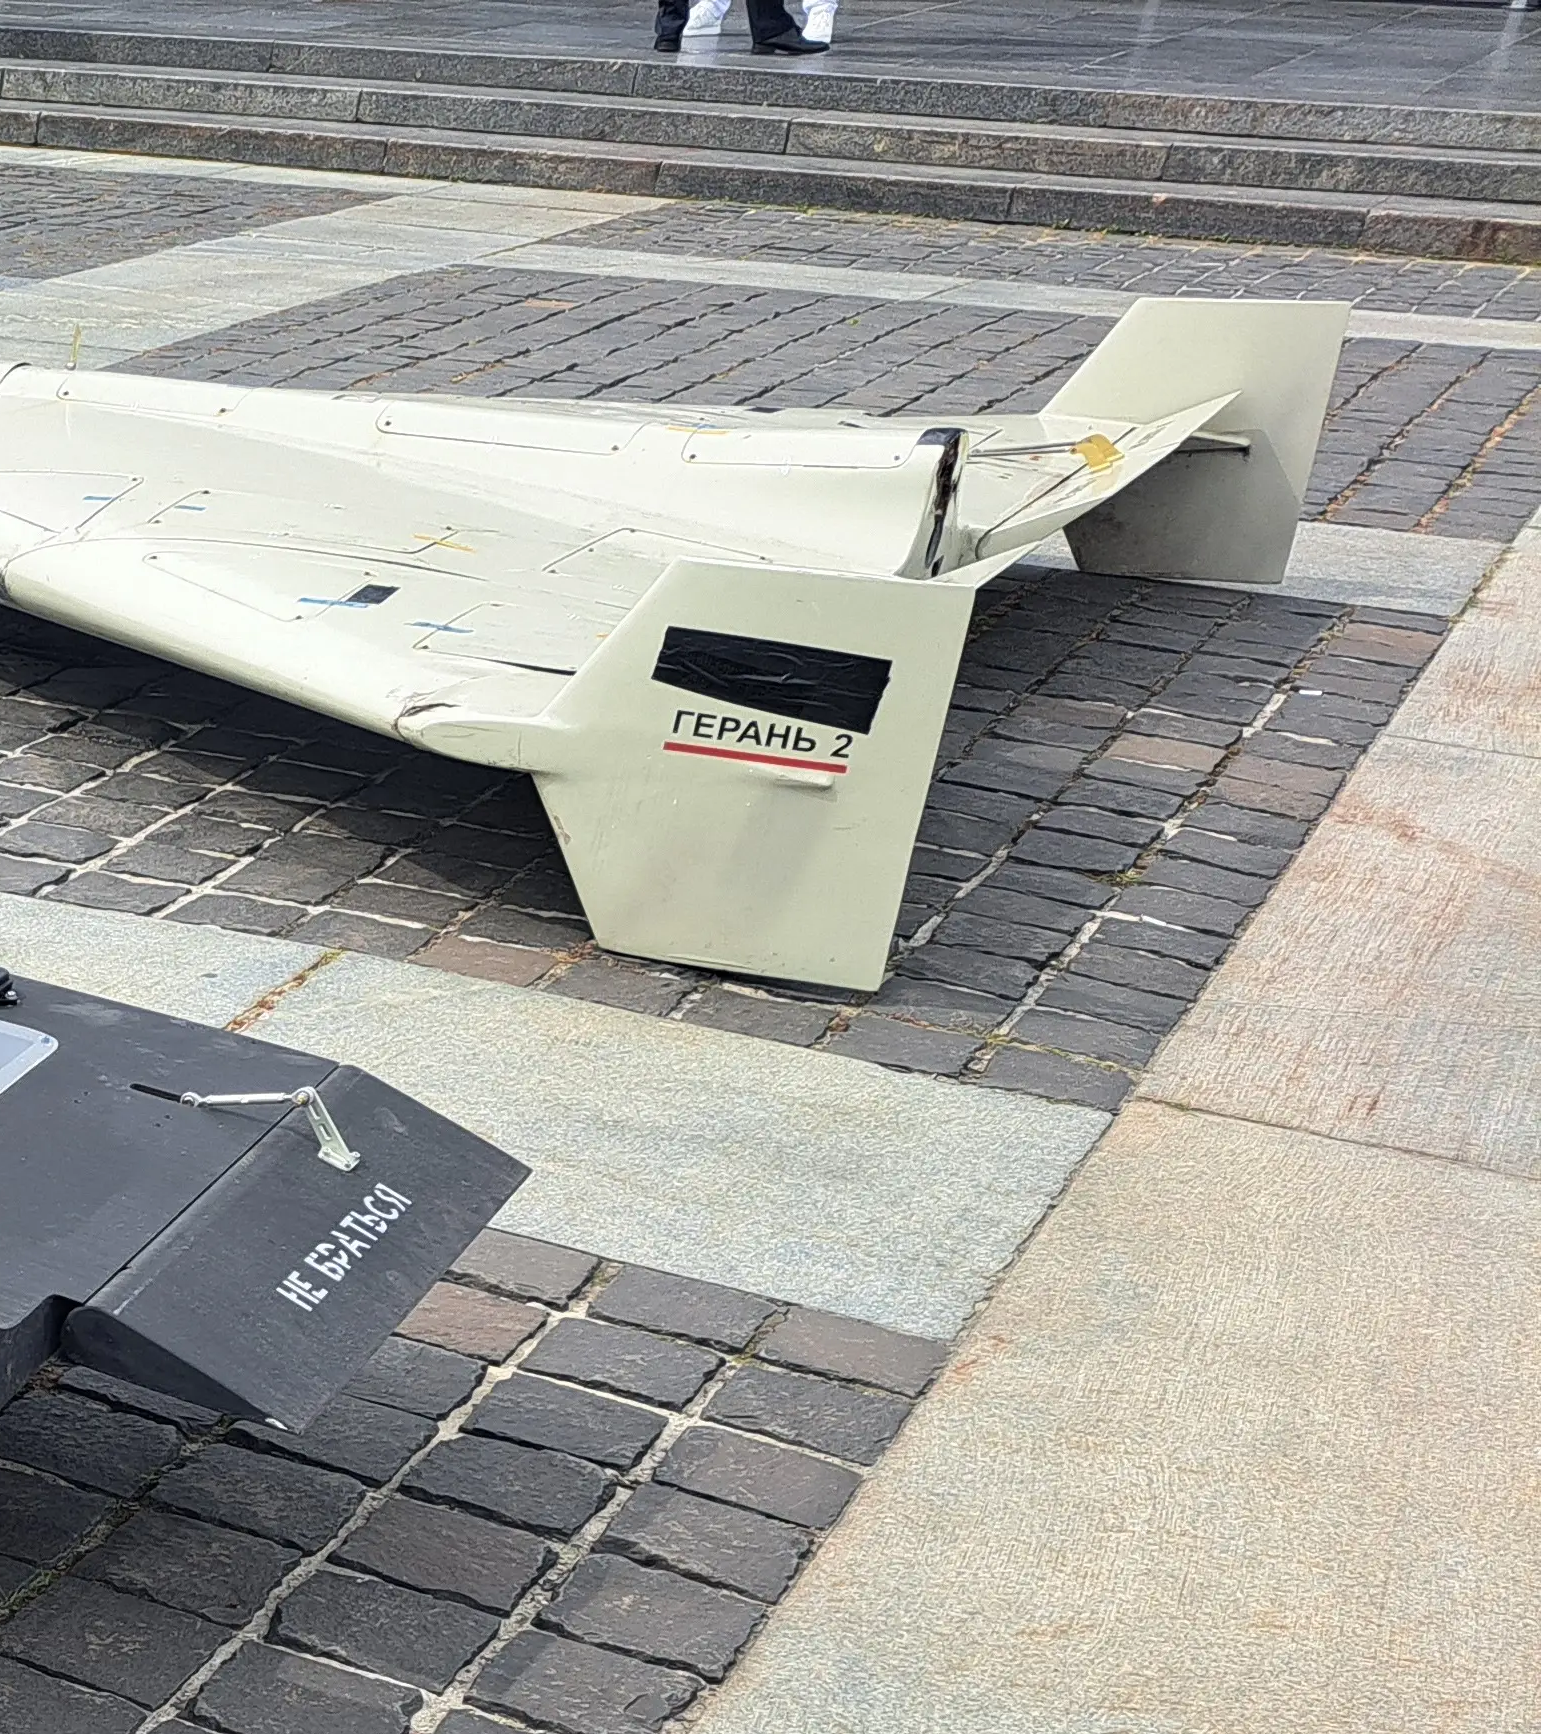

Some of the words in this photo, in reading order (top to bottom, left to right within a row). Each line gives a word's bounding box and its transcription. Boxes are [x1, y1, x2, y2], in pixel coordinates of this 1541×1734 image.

[672, 709, 817, 752] ГЕРАНЬ
[829, 733, 854, 759] 2
[276, 1270, 328, 1312] НЕ
[304, 1182, 412, 1281] БРАТЬСЯ
